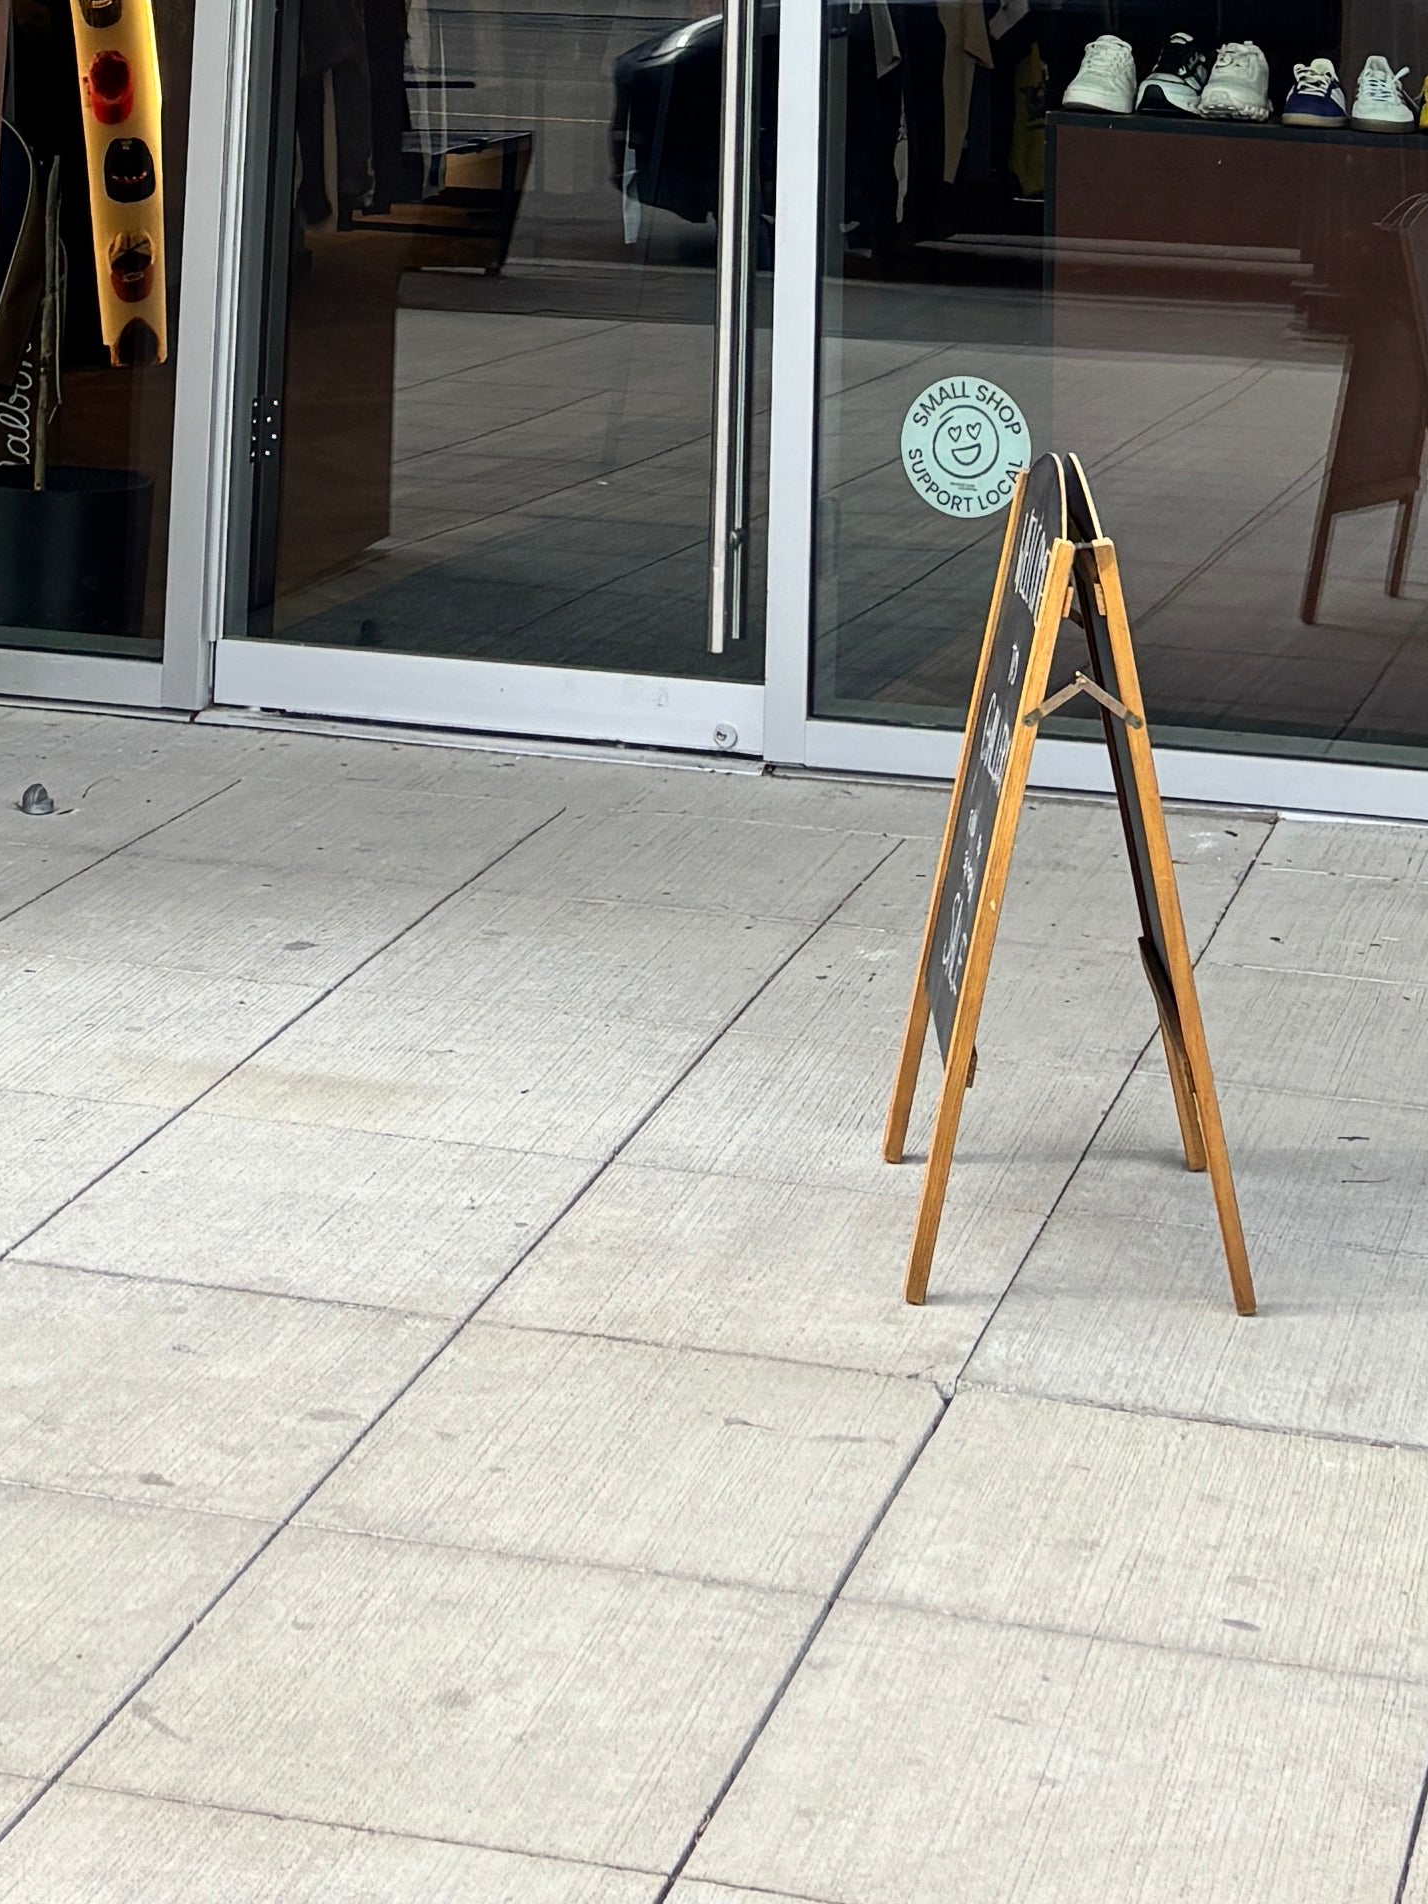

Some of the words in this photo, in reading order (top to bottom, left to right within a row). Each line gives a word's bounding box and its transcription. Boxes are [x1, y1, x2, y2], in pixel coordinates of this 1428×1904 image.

[912, 380, 971, 427] SMALL
[975, 384, 1022, 436] SHOP
[908, 448, 974, 513] SUPPORT
[977, 459, 1024, 511] LOCAL
